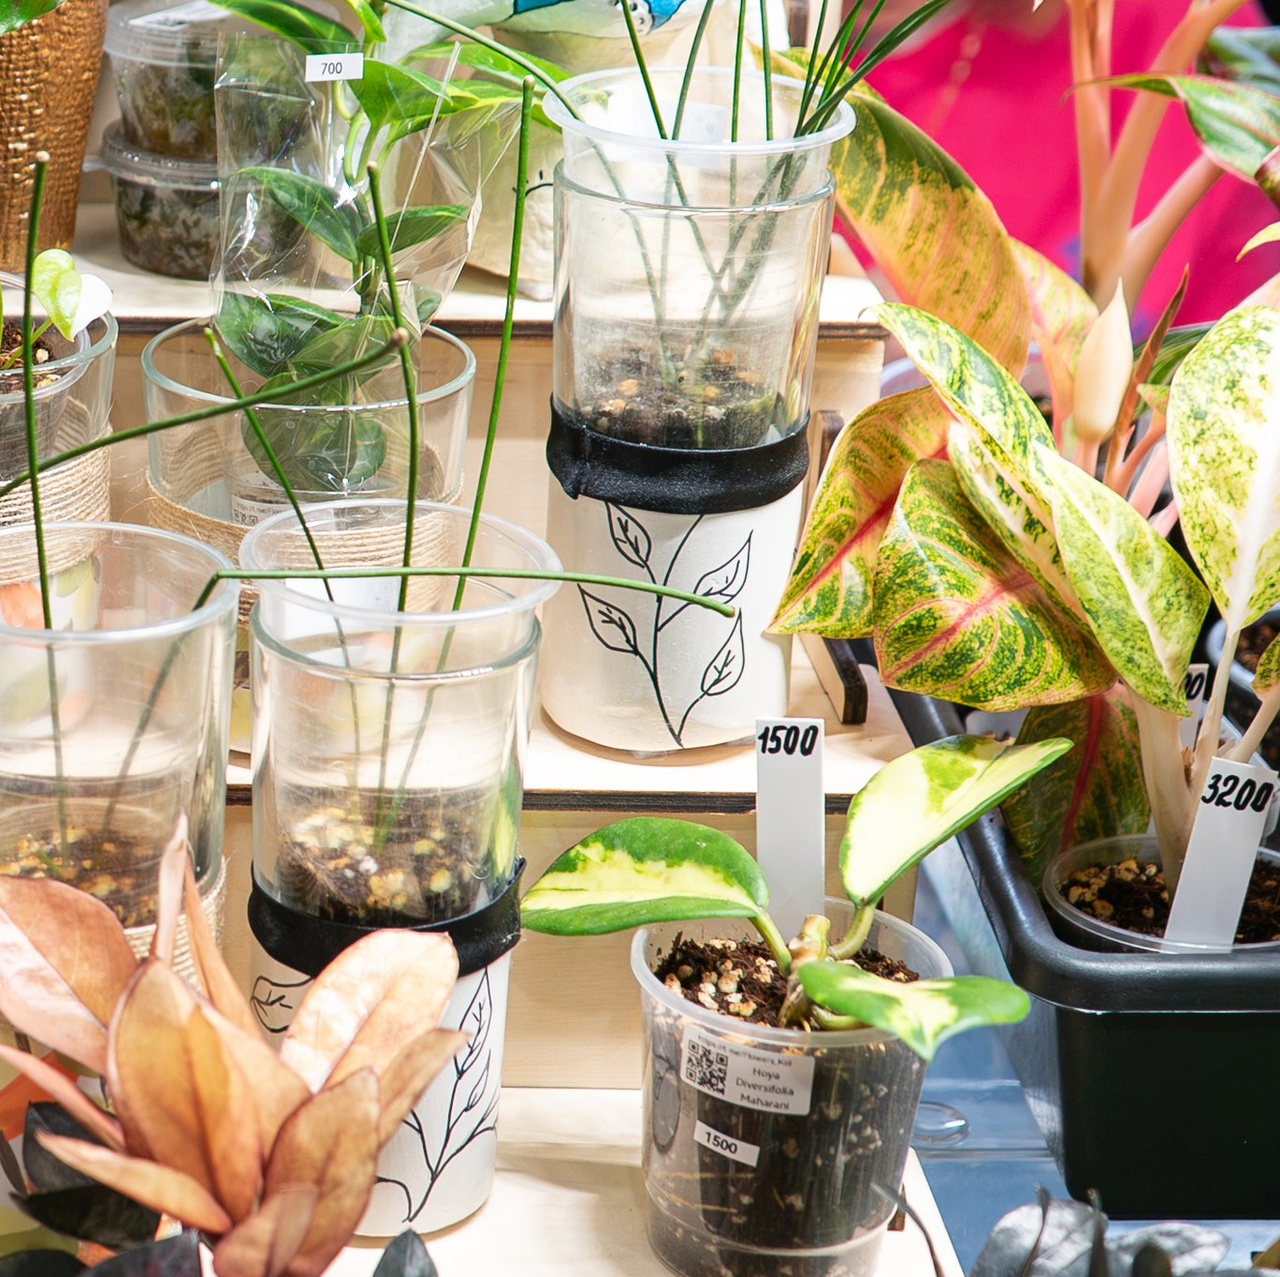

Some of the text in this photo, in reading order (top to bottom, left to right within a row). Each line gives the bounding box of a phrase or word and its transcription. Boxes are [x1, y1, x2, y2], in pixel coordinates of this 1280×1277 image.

[320, 61, 344, 75] 700
[757, 724, 819, 757] 1500
[1200, 773, 1275, 813] 3200
[752, 1066, 781, 1081] Hoya
[739, 1092, 790, 1110] Maharani
[705, 1130, 738, 1155] 1500
